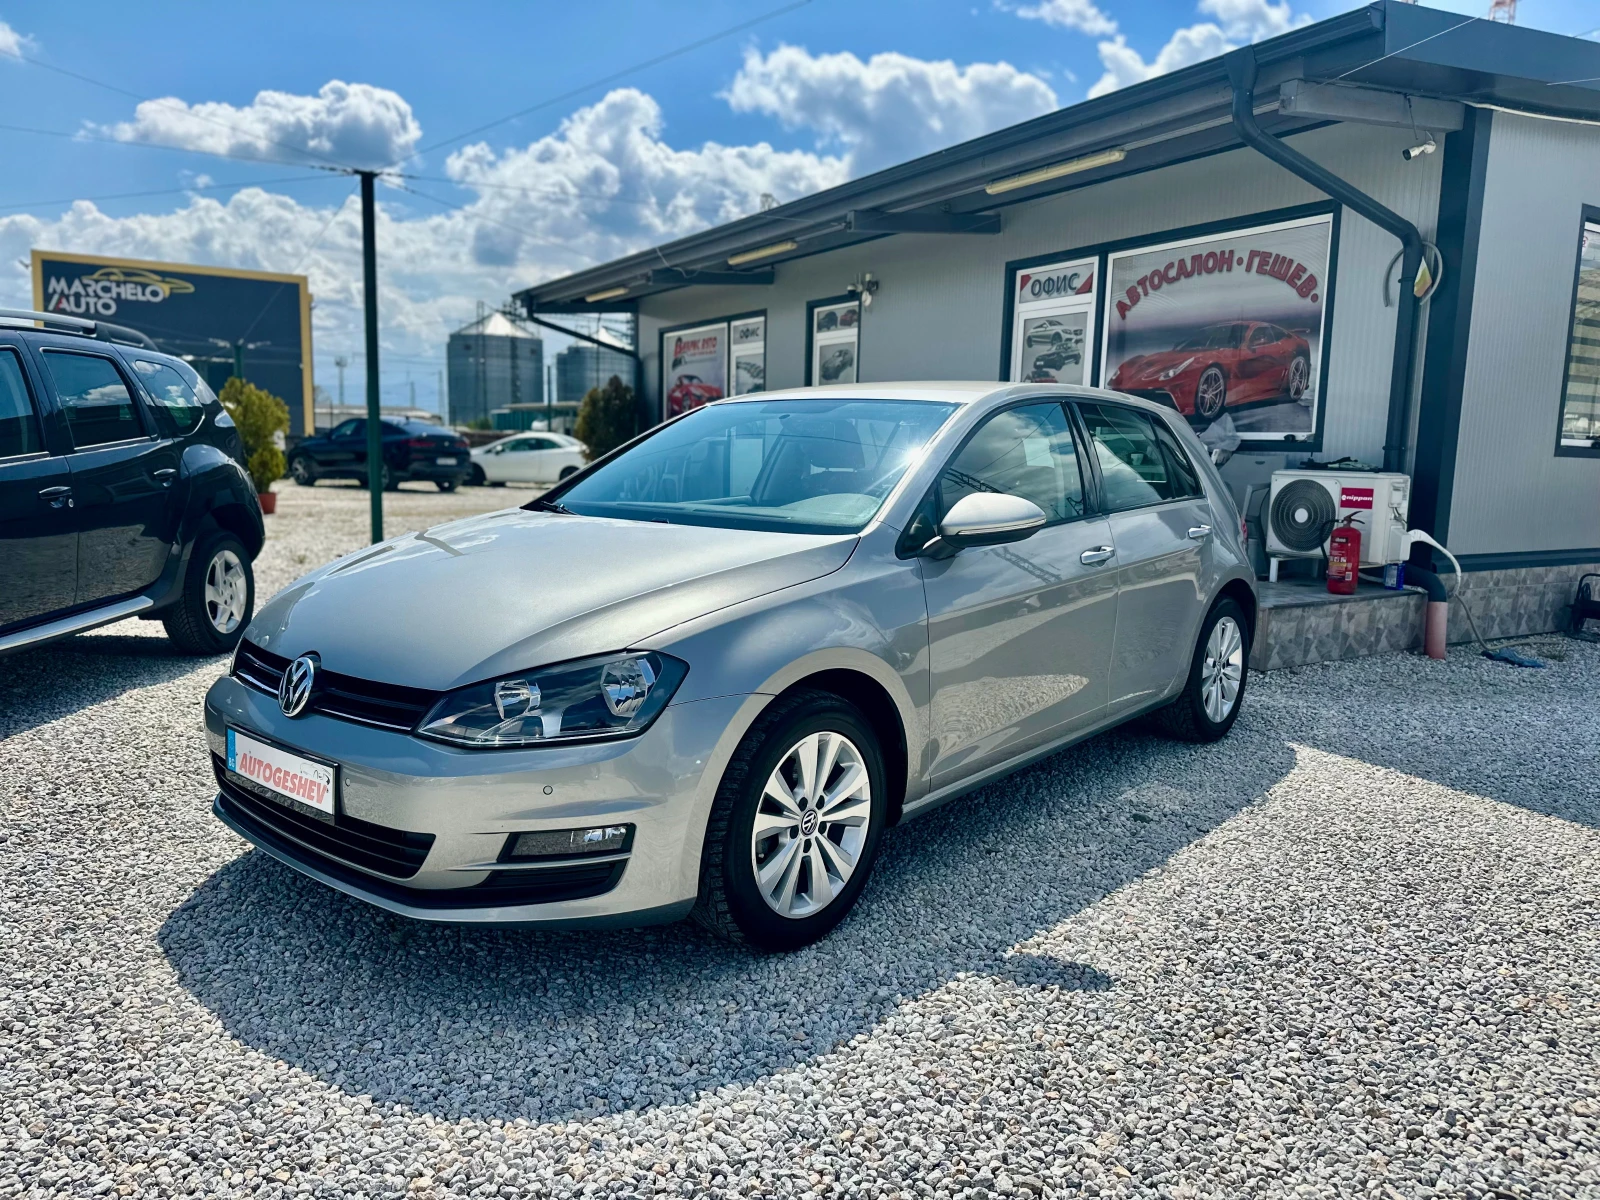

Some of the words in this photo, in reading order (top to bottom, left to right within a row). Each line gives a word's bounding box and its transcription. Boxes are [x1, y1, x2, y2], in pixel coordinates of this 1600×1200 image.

[47, 276, 165, 303] MARCHELO
[1030, 272, 1080, 297] ОФИС
[1115, 249, 1234, 321] АВТОСАЛОН
[1244, 249, 1318, 298] ГЕШЕВ
[239, 752, 328, 805] AUTOGESHEV
